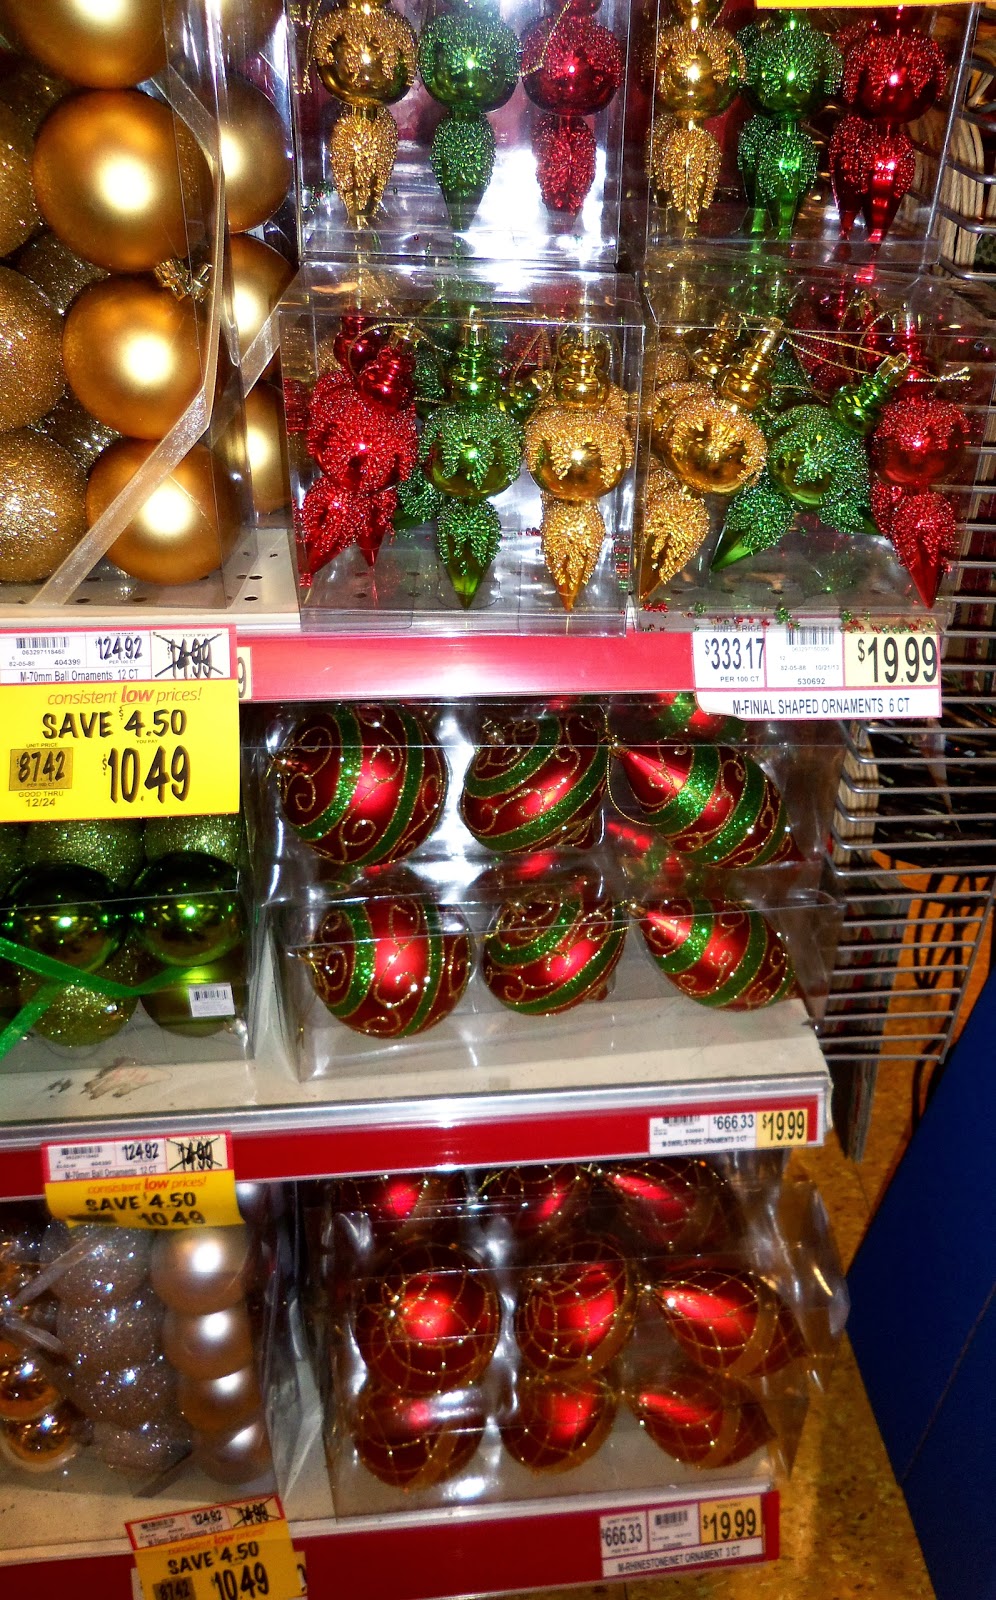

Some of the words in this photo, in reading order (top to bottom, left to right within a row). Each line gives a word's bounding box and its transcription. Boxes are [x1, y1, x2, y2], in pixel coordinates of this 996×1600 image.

[705, 637, 766, 670] $333.17
[857, 636, 938, 684] $19.99
[20, 671, 52, 682] M-70mm
[55, 670, 70, 681] Ball
[71, 669, 113, 681] Ornaments
[118, 669, 127, 680] 12
[128, 668, 139, 680] CT
[48, 690, 117, 706] consistent
[121, 685, 155, 703] low
[156, 687, 202, 705] prices!
[733, 699, 776, 715] M-FINIAL
[778, 698, 819, 714] SHAPED
[821, 698, 884, 714] ORNAMENTS
[889, 698, 895, 713] 6
[897, 697, 910, 713] CT
[42, 710, 114, 739] SAVE
[118, 706, 188, 738] $4.50
[102, 745, 191, 804] $10.49
[25, 797, 56, 808] 12/24
[762, 1110, 805, 1142] $19.99
[144, 1178, 170, 1191] low
[85, 1195, 140, 1212] SAVE
[703, 1508, 757, 1541] $19.99
[167, 1550, 214, 1575] SAVE
